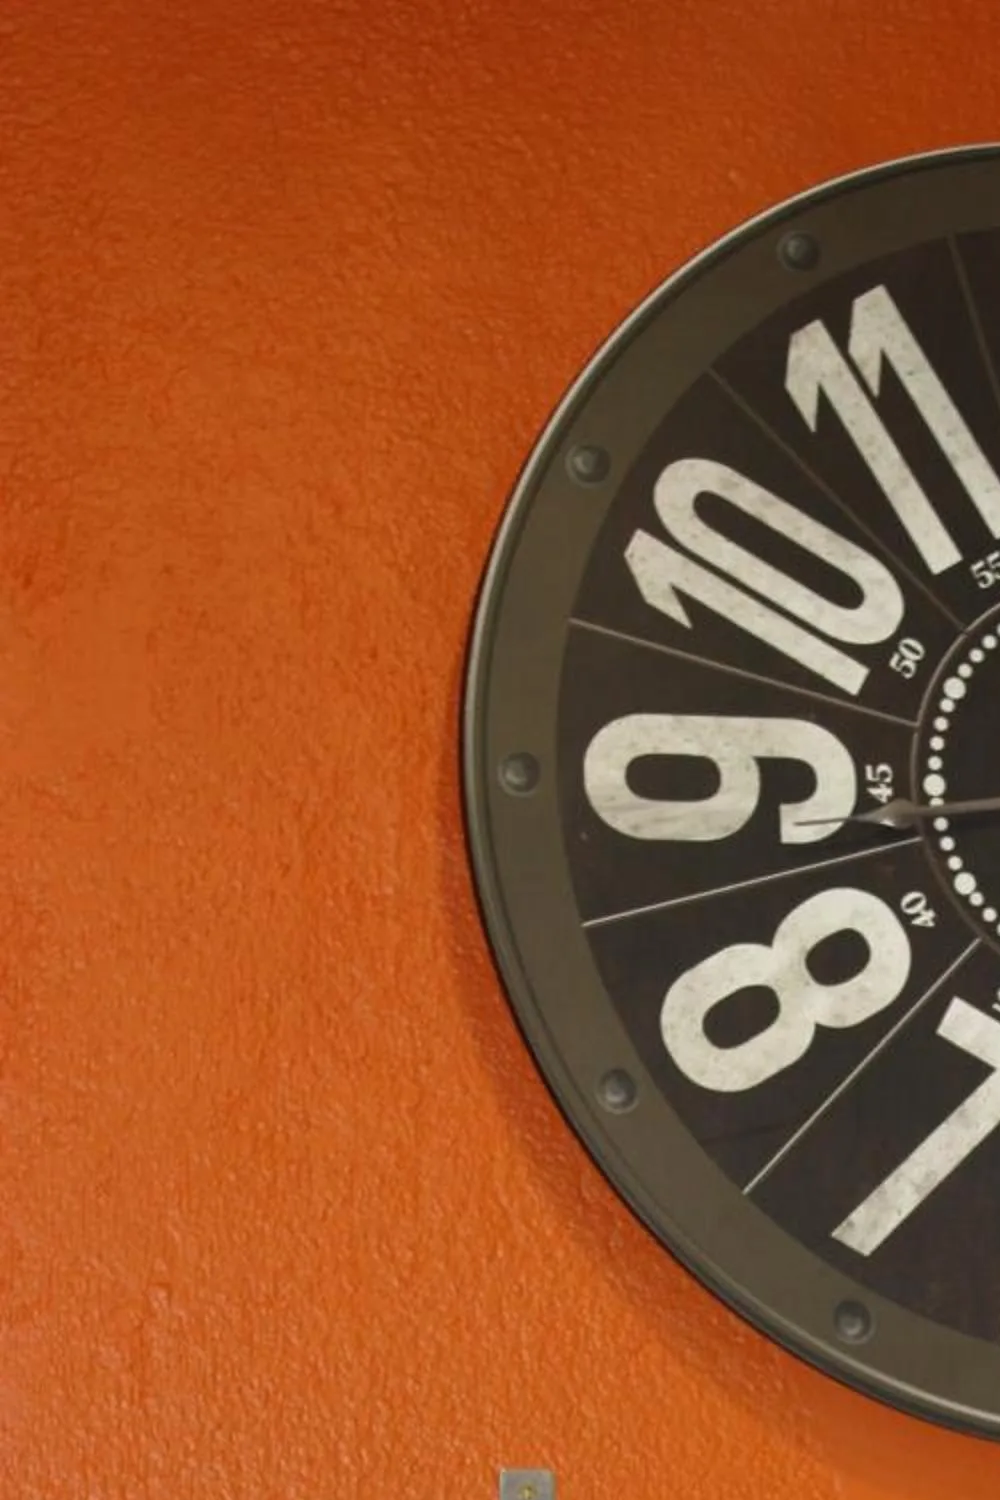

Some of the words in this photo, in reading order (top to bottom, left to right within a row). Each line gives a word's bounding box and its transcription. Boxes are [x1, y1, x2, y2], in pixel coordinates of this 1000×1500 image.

[624, 458, 905, 696] 10
[890, 638, 925, 679] 50
[584, 714, 857, 845] 9
[865, 764, 894, 803] 45
[902, 891, 937, 929] 40
[660, 888, 911, 1093] 8
